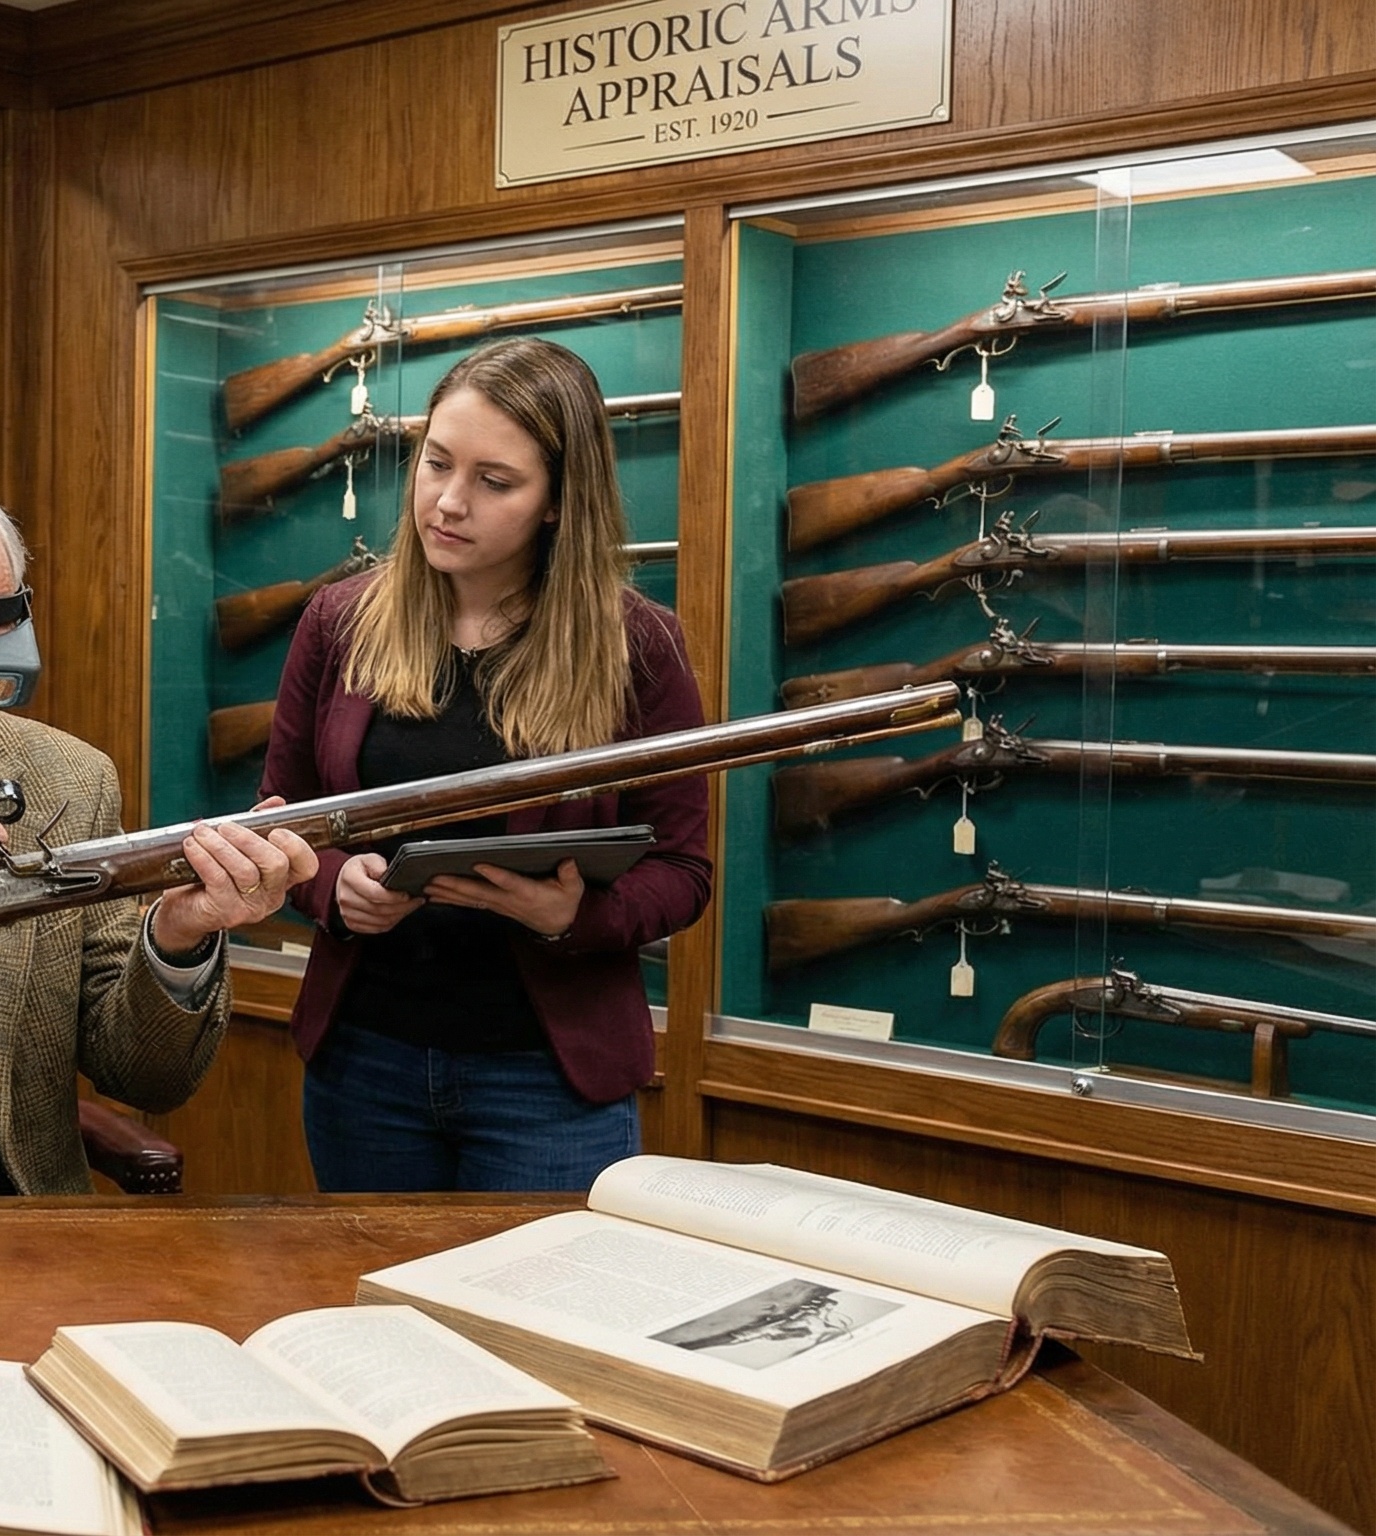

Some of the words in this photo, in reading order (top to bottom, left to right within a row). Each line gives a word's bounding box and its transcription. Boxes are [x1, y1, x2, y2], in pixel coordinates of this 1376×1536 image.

[522, 2, 747, 84] HISTORIC
[562, 35, 862, 126] APPRAISALS
[654, 118, 701, 144] EST.
[710, 108, 758, 135] 1920
